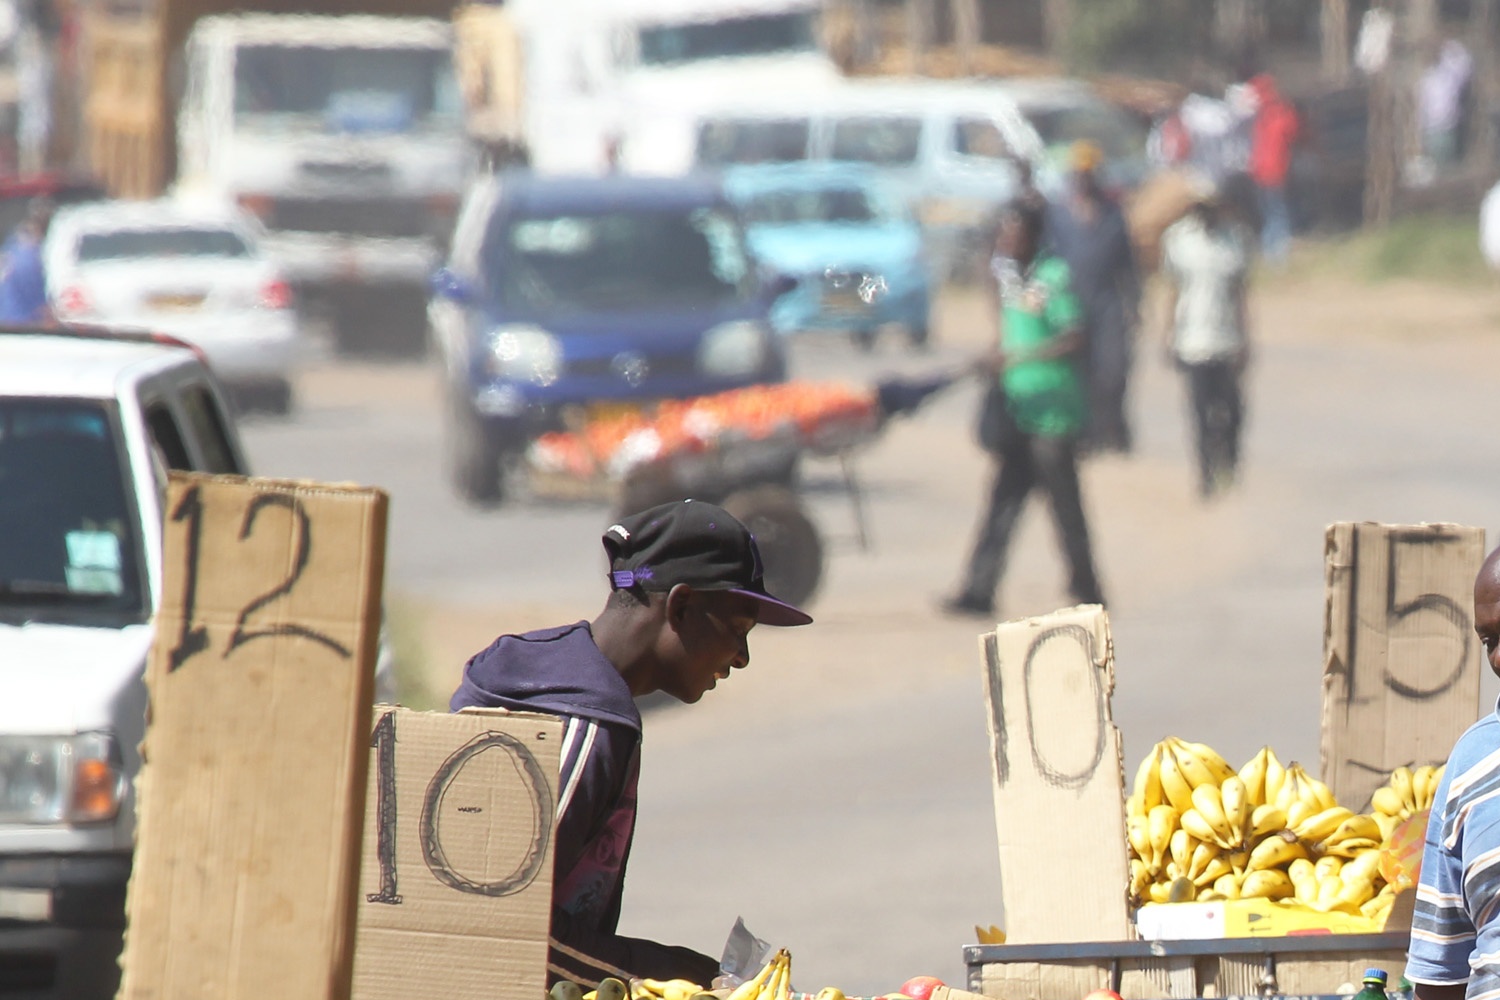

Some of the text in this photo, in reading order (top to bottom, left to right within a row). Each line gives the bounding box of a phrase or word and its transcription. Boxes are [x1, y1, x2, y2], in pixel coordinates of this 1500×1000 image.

[167, 485, 352, 672] 12
[1336, 522, 1471, 715] 15
[981, 623, 1108, 790] 10
[365, 712, 553, 905] 10
